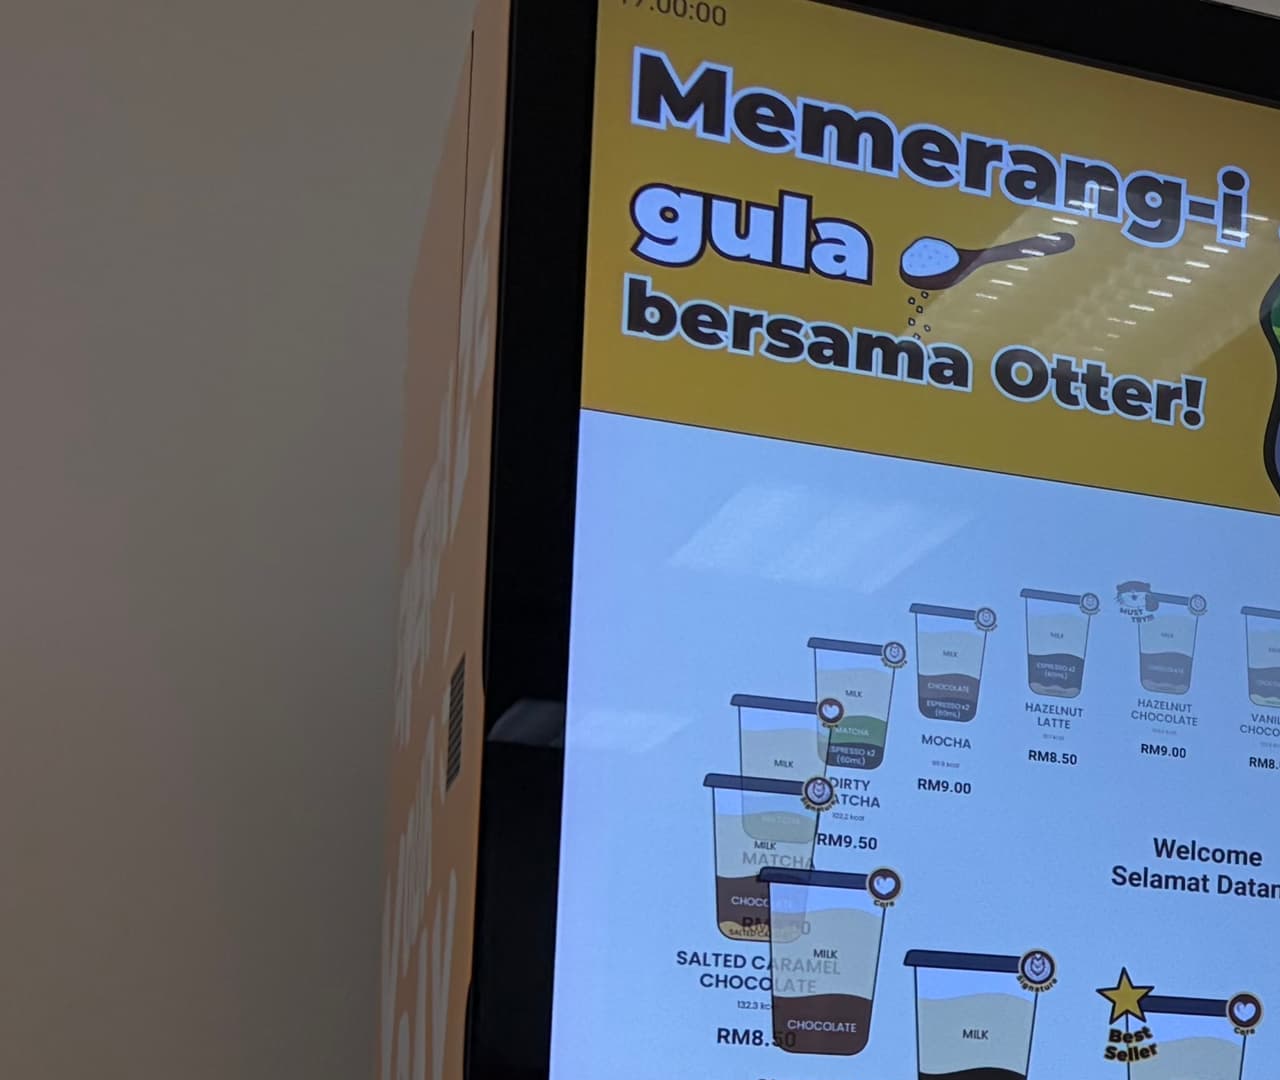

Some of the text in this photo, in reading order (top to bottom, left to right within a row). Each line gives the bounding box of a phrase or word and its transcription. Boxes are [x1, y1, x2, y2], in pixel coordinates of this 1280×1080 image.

[631, 45, 1249, 248] Memerang-i
[630, 181, 874, 286] gula
[622, 272, 1206, 429] bersama Otter!
[1025, 701, 1083, 717] HAZELNUT
[1137, 698, 1192, 713] HAZELNUT
[1037, 717, 1071, 729] LATTE
[1131, 710, 1198, 727] CHOCOLATE
[921, 734, 971, 749] MOCHA
[1028, 749, 1077, 766] RM8.50
[1140, 743, 1187, 759] RM9.00
[829, 777, 870, 791] DIRTY
[918, 778, 971, 794] RM9.00
[754, 840, 777, 850] MILK
[817, 832, 877, 850] RM9.50
[1152, 837, 1263, 867] Welcome
[1111, 865, 1210, 893] Selamat
[676, 950, 841, 975] SALTED CARAMEL
[813, 949, 838, 959] MILK
[700, 973, 817, 994] CHOCOLATE
[787, 1019, 857, 1033] CHOCOLATE
[962, 1028, 989, 1040] MILK
[717, 1027, 797, 1048] RM8.50
[1107, 1026, 1153, 1044] Best
[1103, 1042, 1158, 1063] Seller
